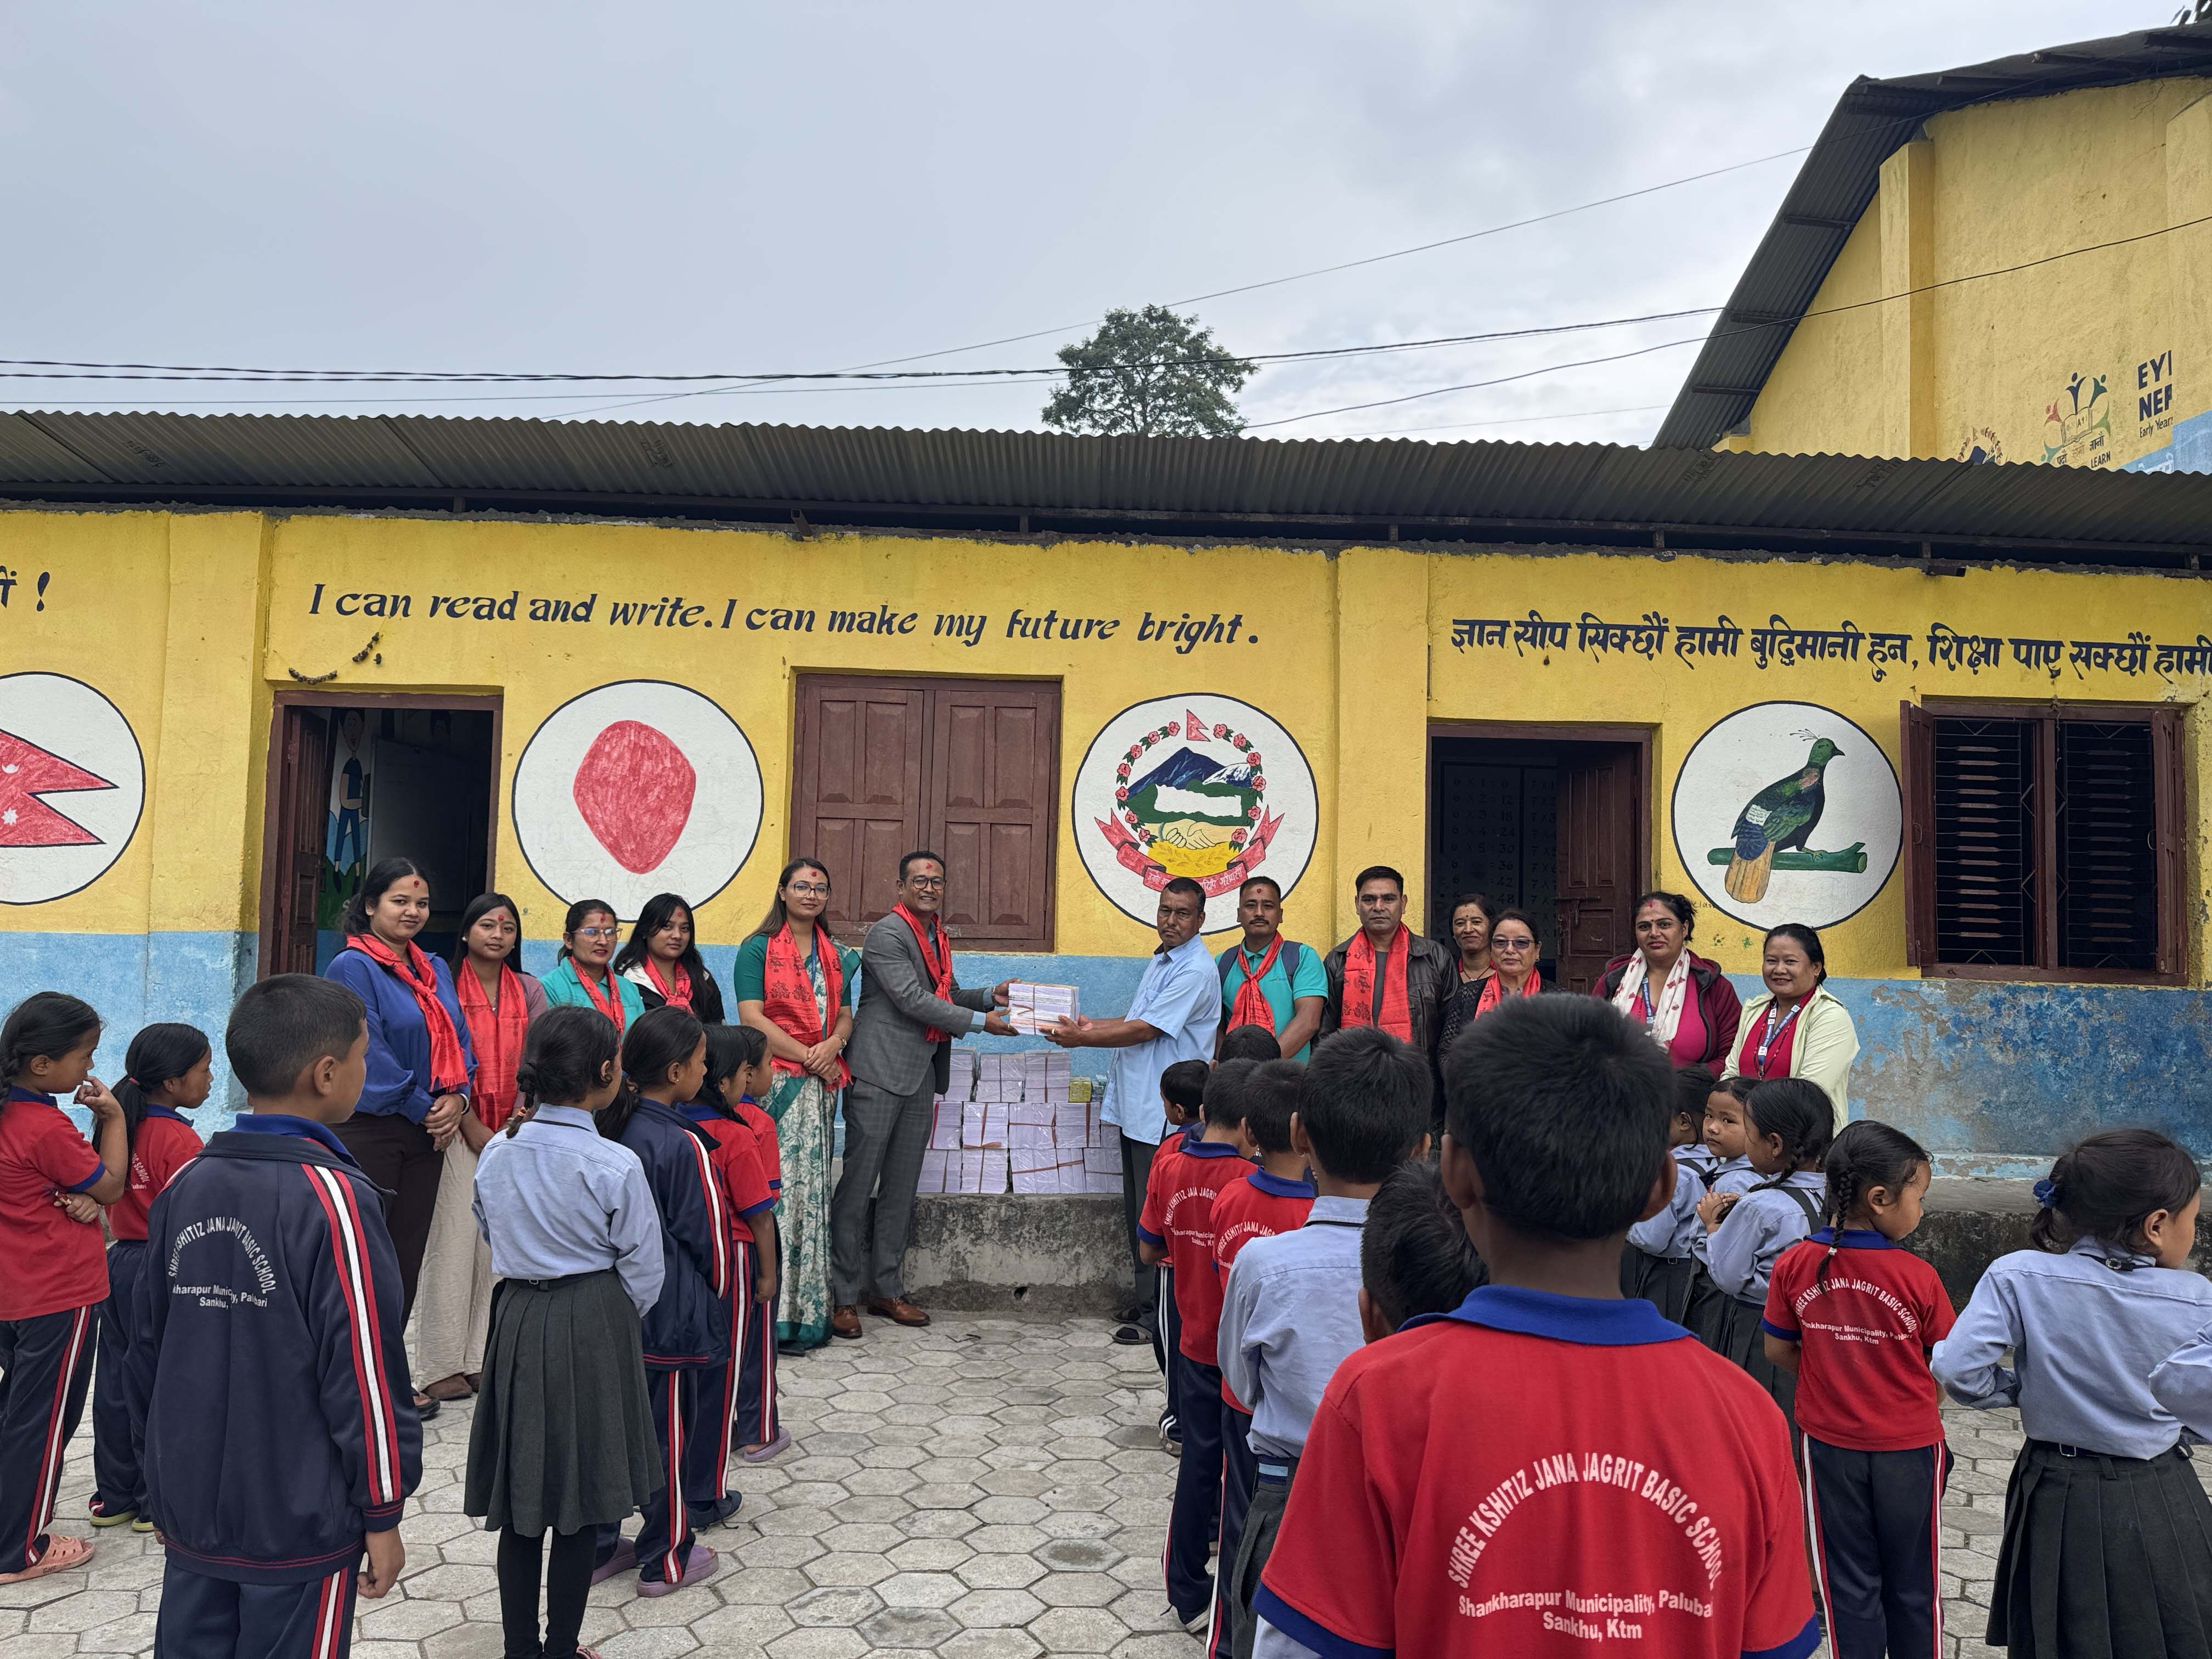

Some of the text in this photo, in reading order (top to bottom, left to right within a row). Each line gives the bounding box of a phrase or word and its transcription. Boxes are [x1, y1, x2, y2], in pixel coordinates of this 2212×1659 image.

[2140, 422, 2154, 438] Early
[2091, 451, 2111, 469] LEARN
[309, 583, 1259, 654] I can read and write. I can make my future bright.
[1451, 618, 1512, 654] ज्ञान
[1674, 614, 1745, 670] हामी
[1927, 622, 2004, 675] शिक्षा
[2008, 638, 2066, 678] पाए
[133, 1162, 150, 1183] SCHOOL
[1243, 1221, 1259, 1234] JANA
[206, 1216, 225, 1234] JANA
[241, 1230, 261, 1259] BASIC
[252, 1254, 276, 1294] SCHOOL
[1831, 1277, 1850, 1290] JANA
[1852, 1278, 1880, 1296] JAGRIT
[1878, 1290, 1903, 1311] BASIC
[1897, 1307, 1917, 1333] SCHOOL
[1835, 1333, 1880, 1345] Sankhu, Ktm
[1448, 1452, 1723, 1592] SHREE KSHITIZ JANA JAGRIT BASIC SCHOOL
[1459, 1592, 1562, 1618] Shankharapur
[1543, 1611, 1642, 1643] Sankhu, Ktm
